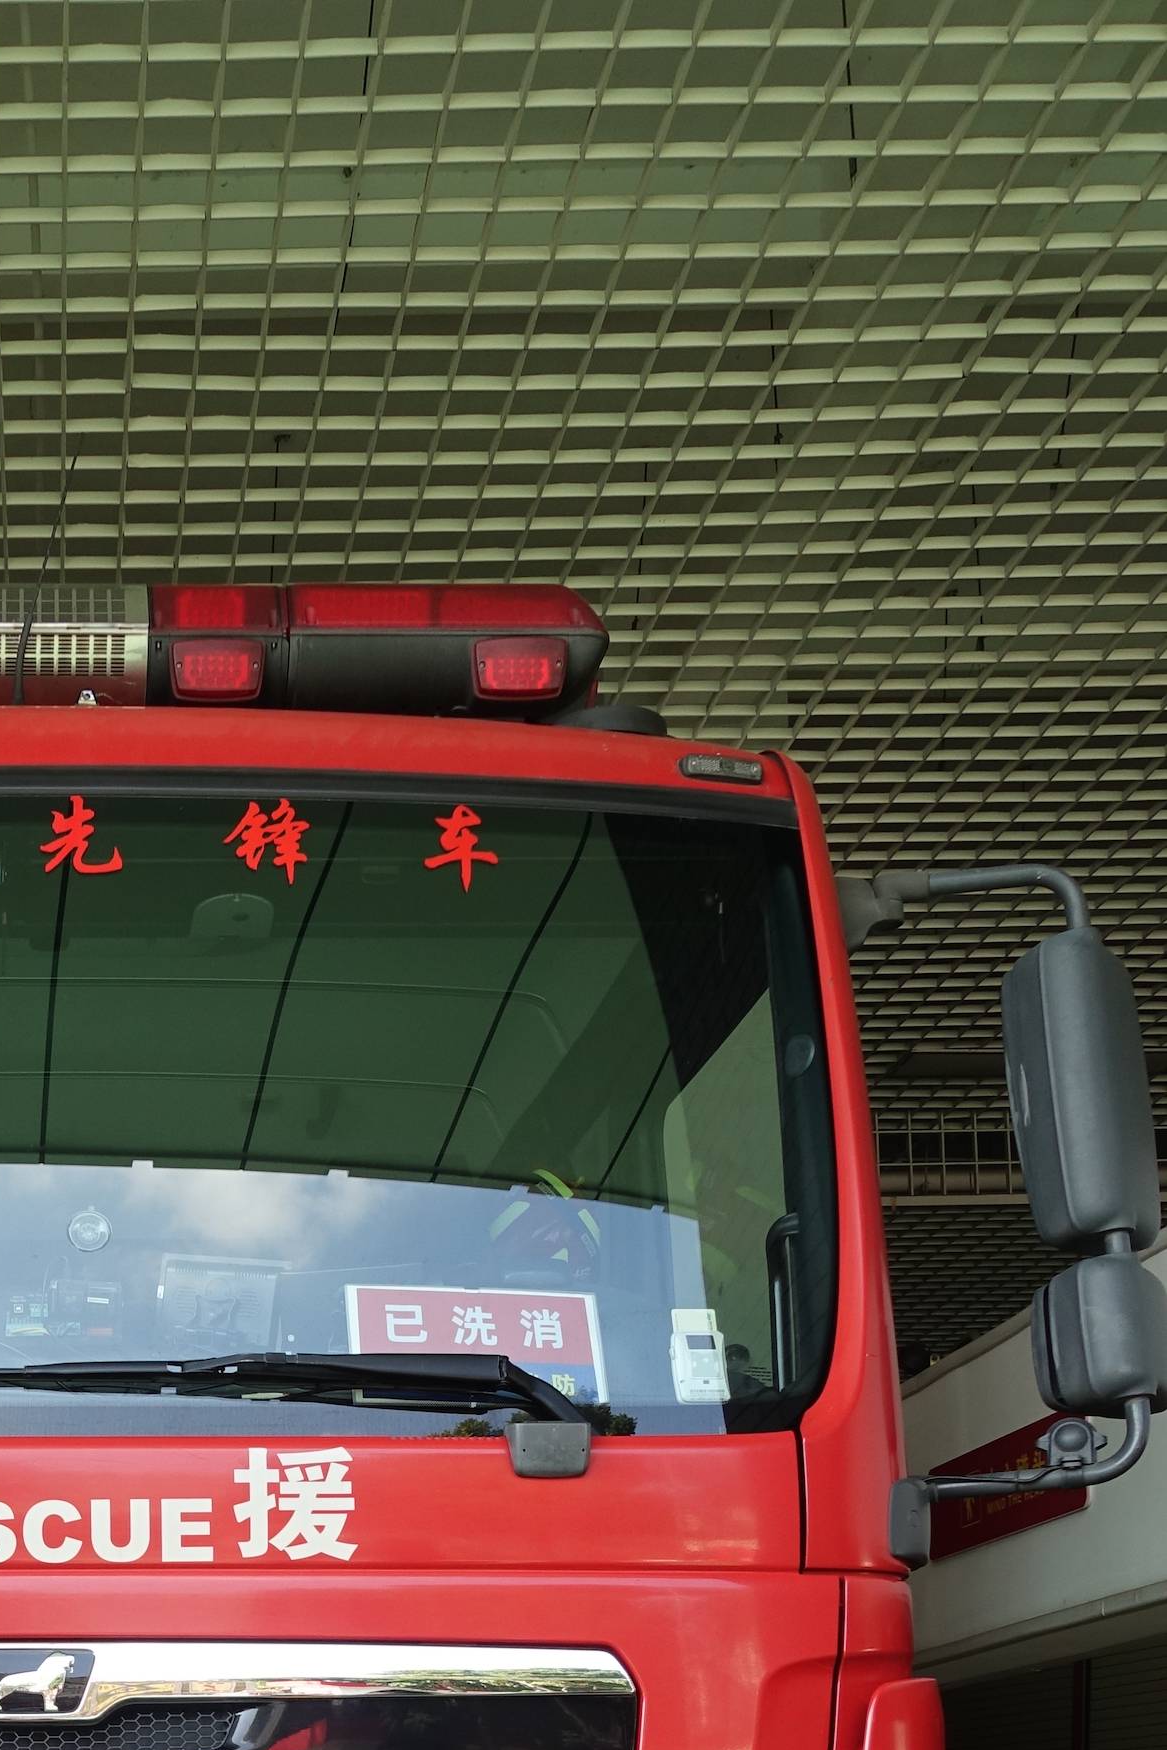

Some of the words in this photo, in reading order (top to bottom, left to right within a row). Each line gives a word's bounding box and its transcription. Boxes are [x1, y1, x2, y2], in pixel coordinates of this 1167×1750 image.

[383, 1303, 564, 1350] 已洗消
[233, 1446, 358, 1562] 援
